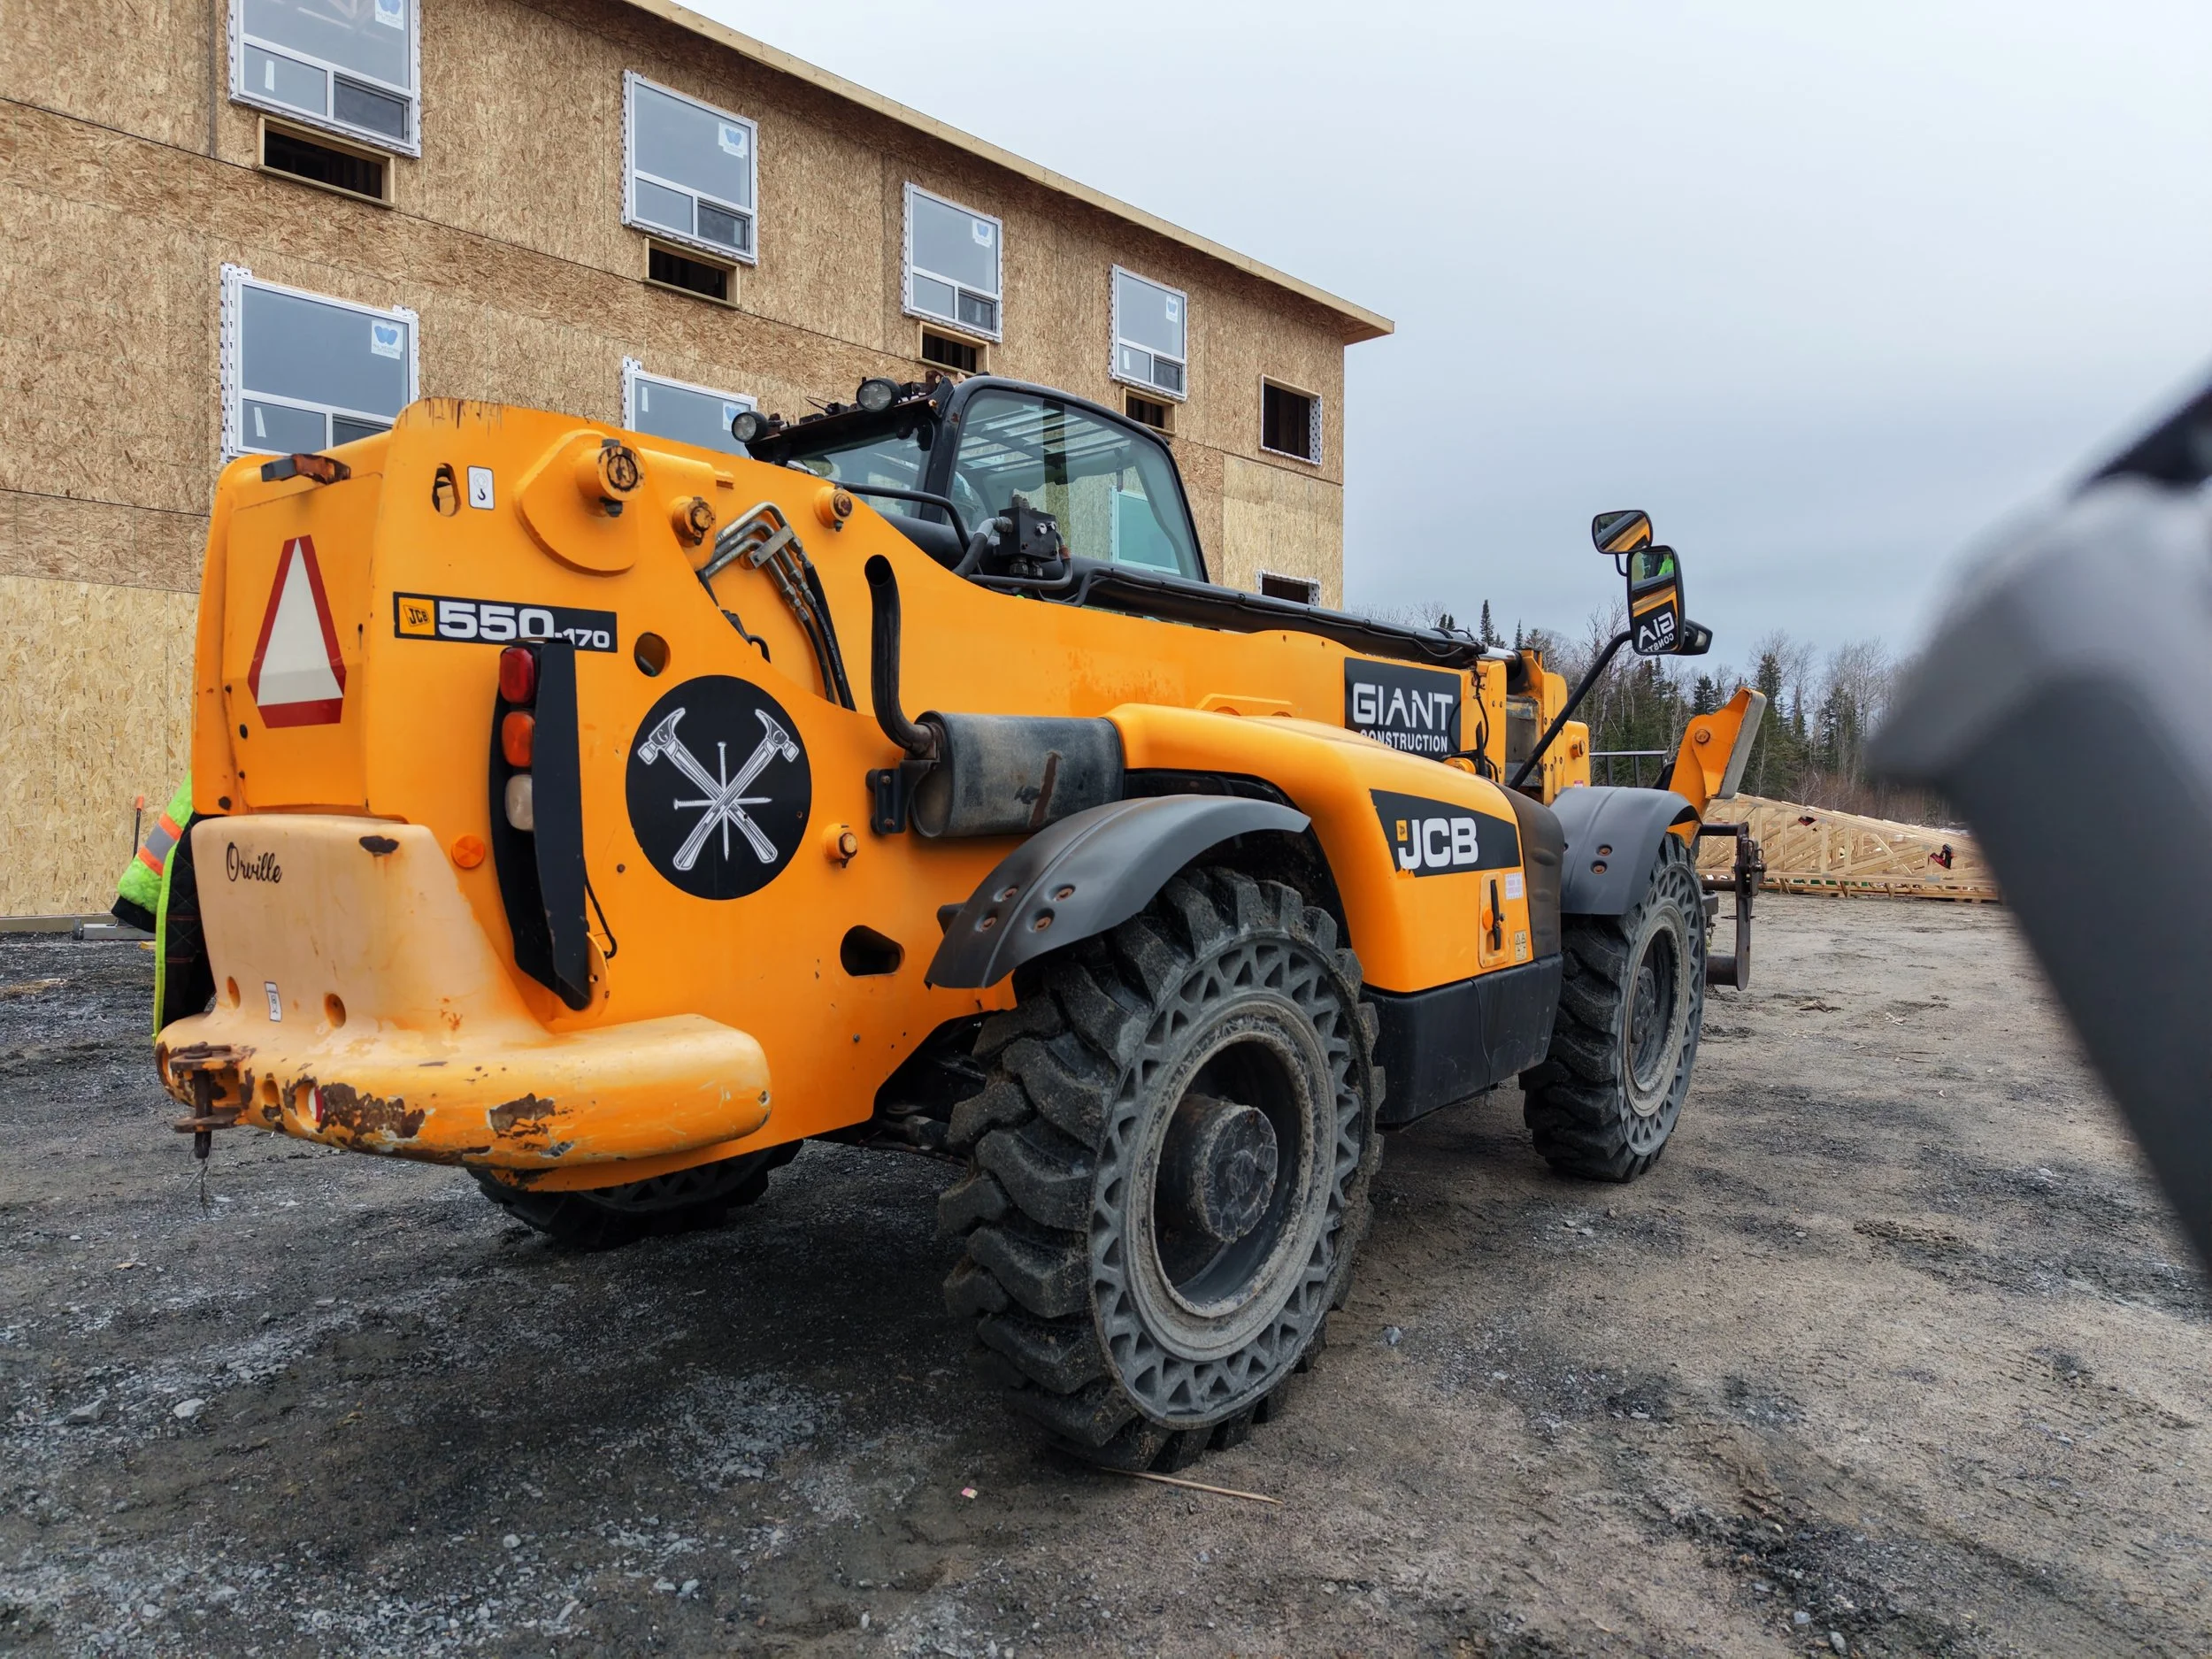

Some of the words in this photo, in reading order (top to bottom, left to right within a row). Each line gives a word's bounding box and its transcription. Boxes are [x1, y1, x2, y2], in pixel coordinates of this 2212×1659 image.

[408, 607, 428, 625] JCB
[1353, 682, 1454, 731] GIANT
[227, 841, 282, 883] Orville
[1398, 818, 1479, 870] JCB
